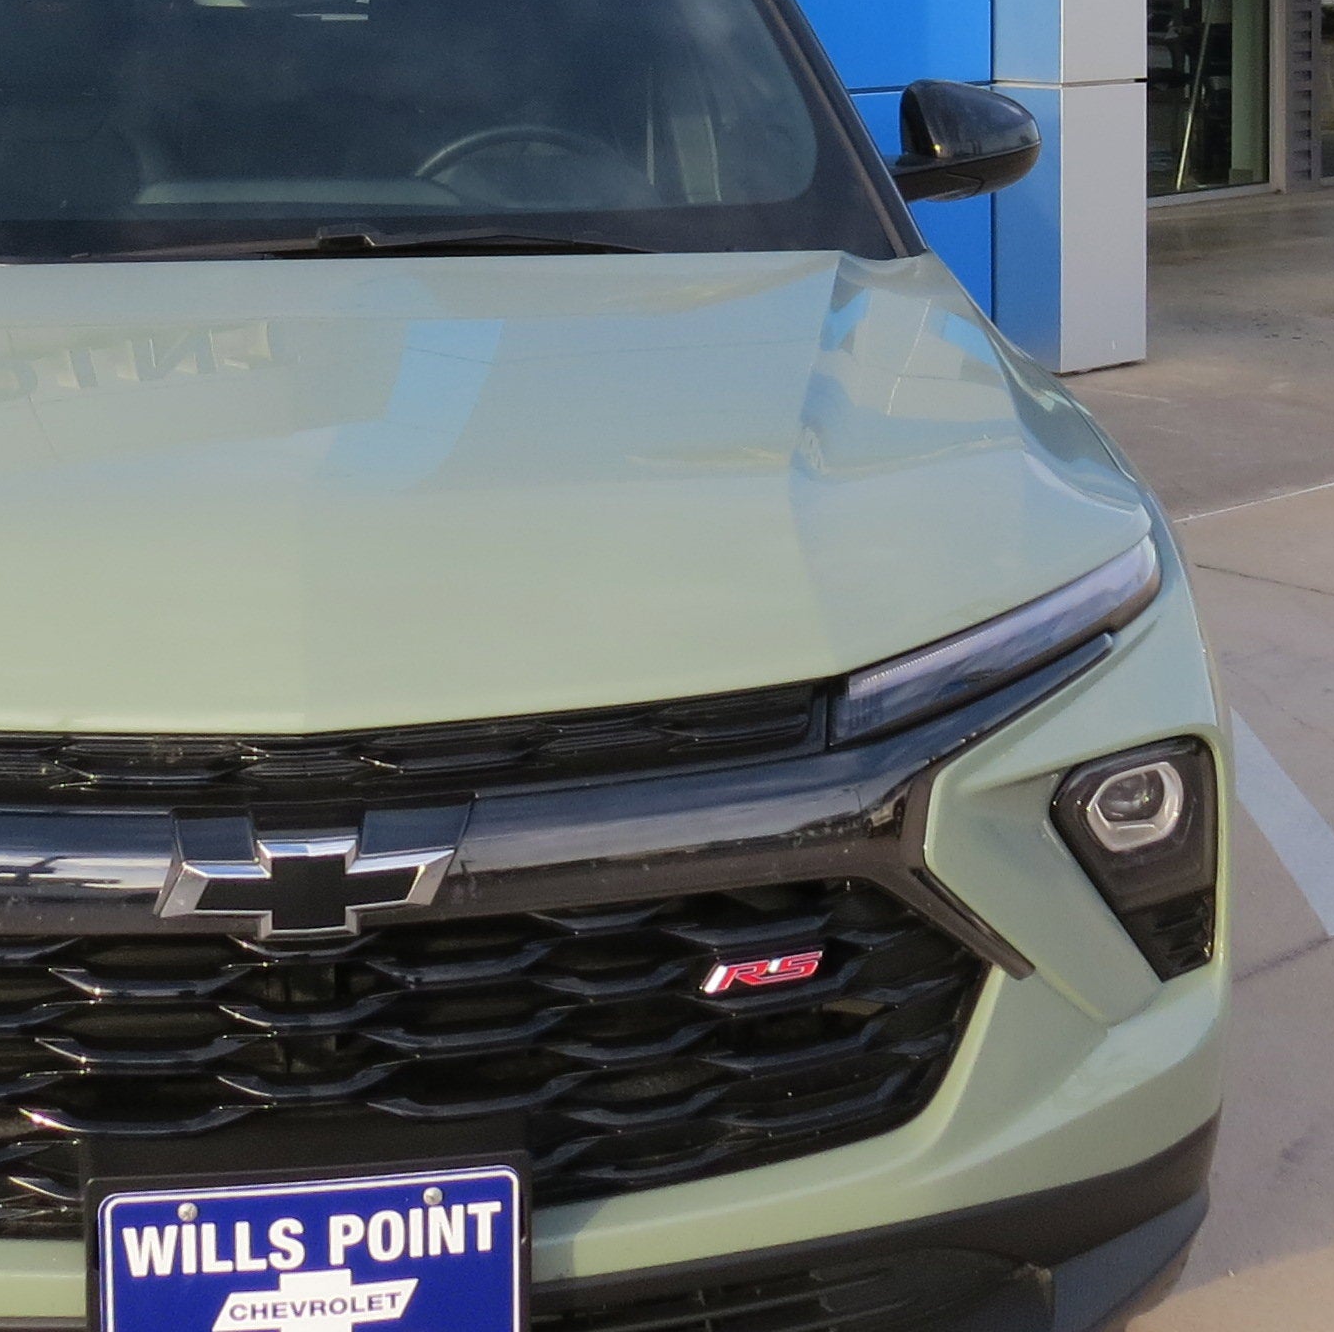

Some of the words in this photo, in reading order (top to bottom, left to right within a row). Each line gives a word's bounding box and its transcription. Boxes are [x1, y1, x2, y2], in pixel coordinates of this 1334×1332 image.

[703, 951, 823, 994] RS
[122, 1218, 305, 1276] WILLS
[329, 1202, 501, 1265] POINT
[229, 1292, 402, 1321] CHEVROLET
